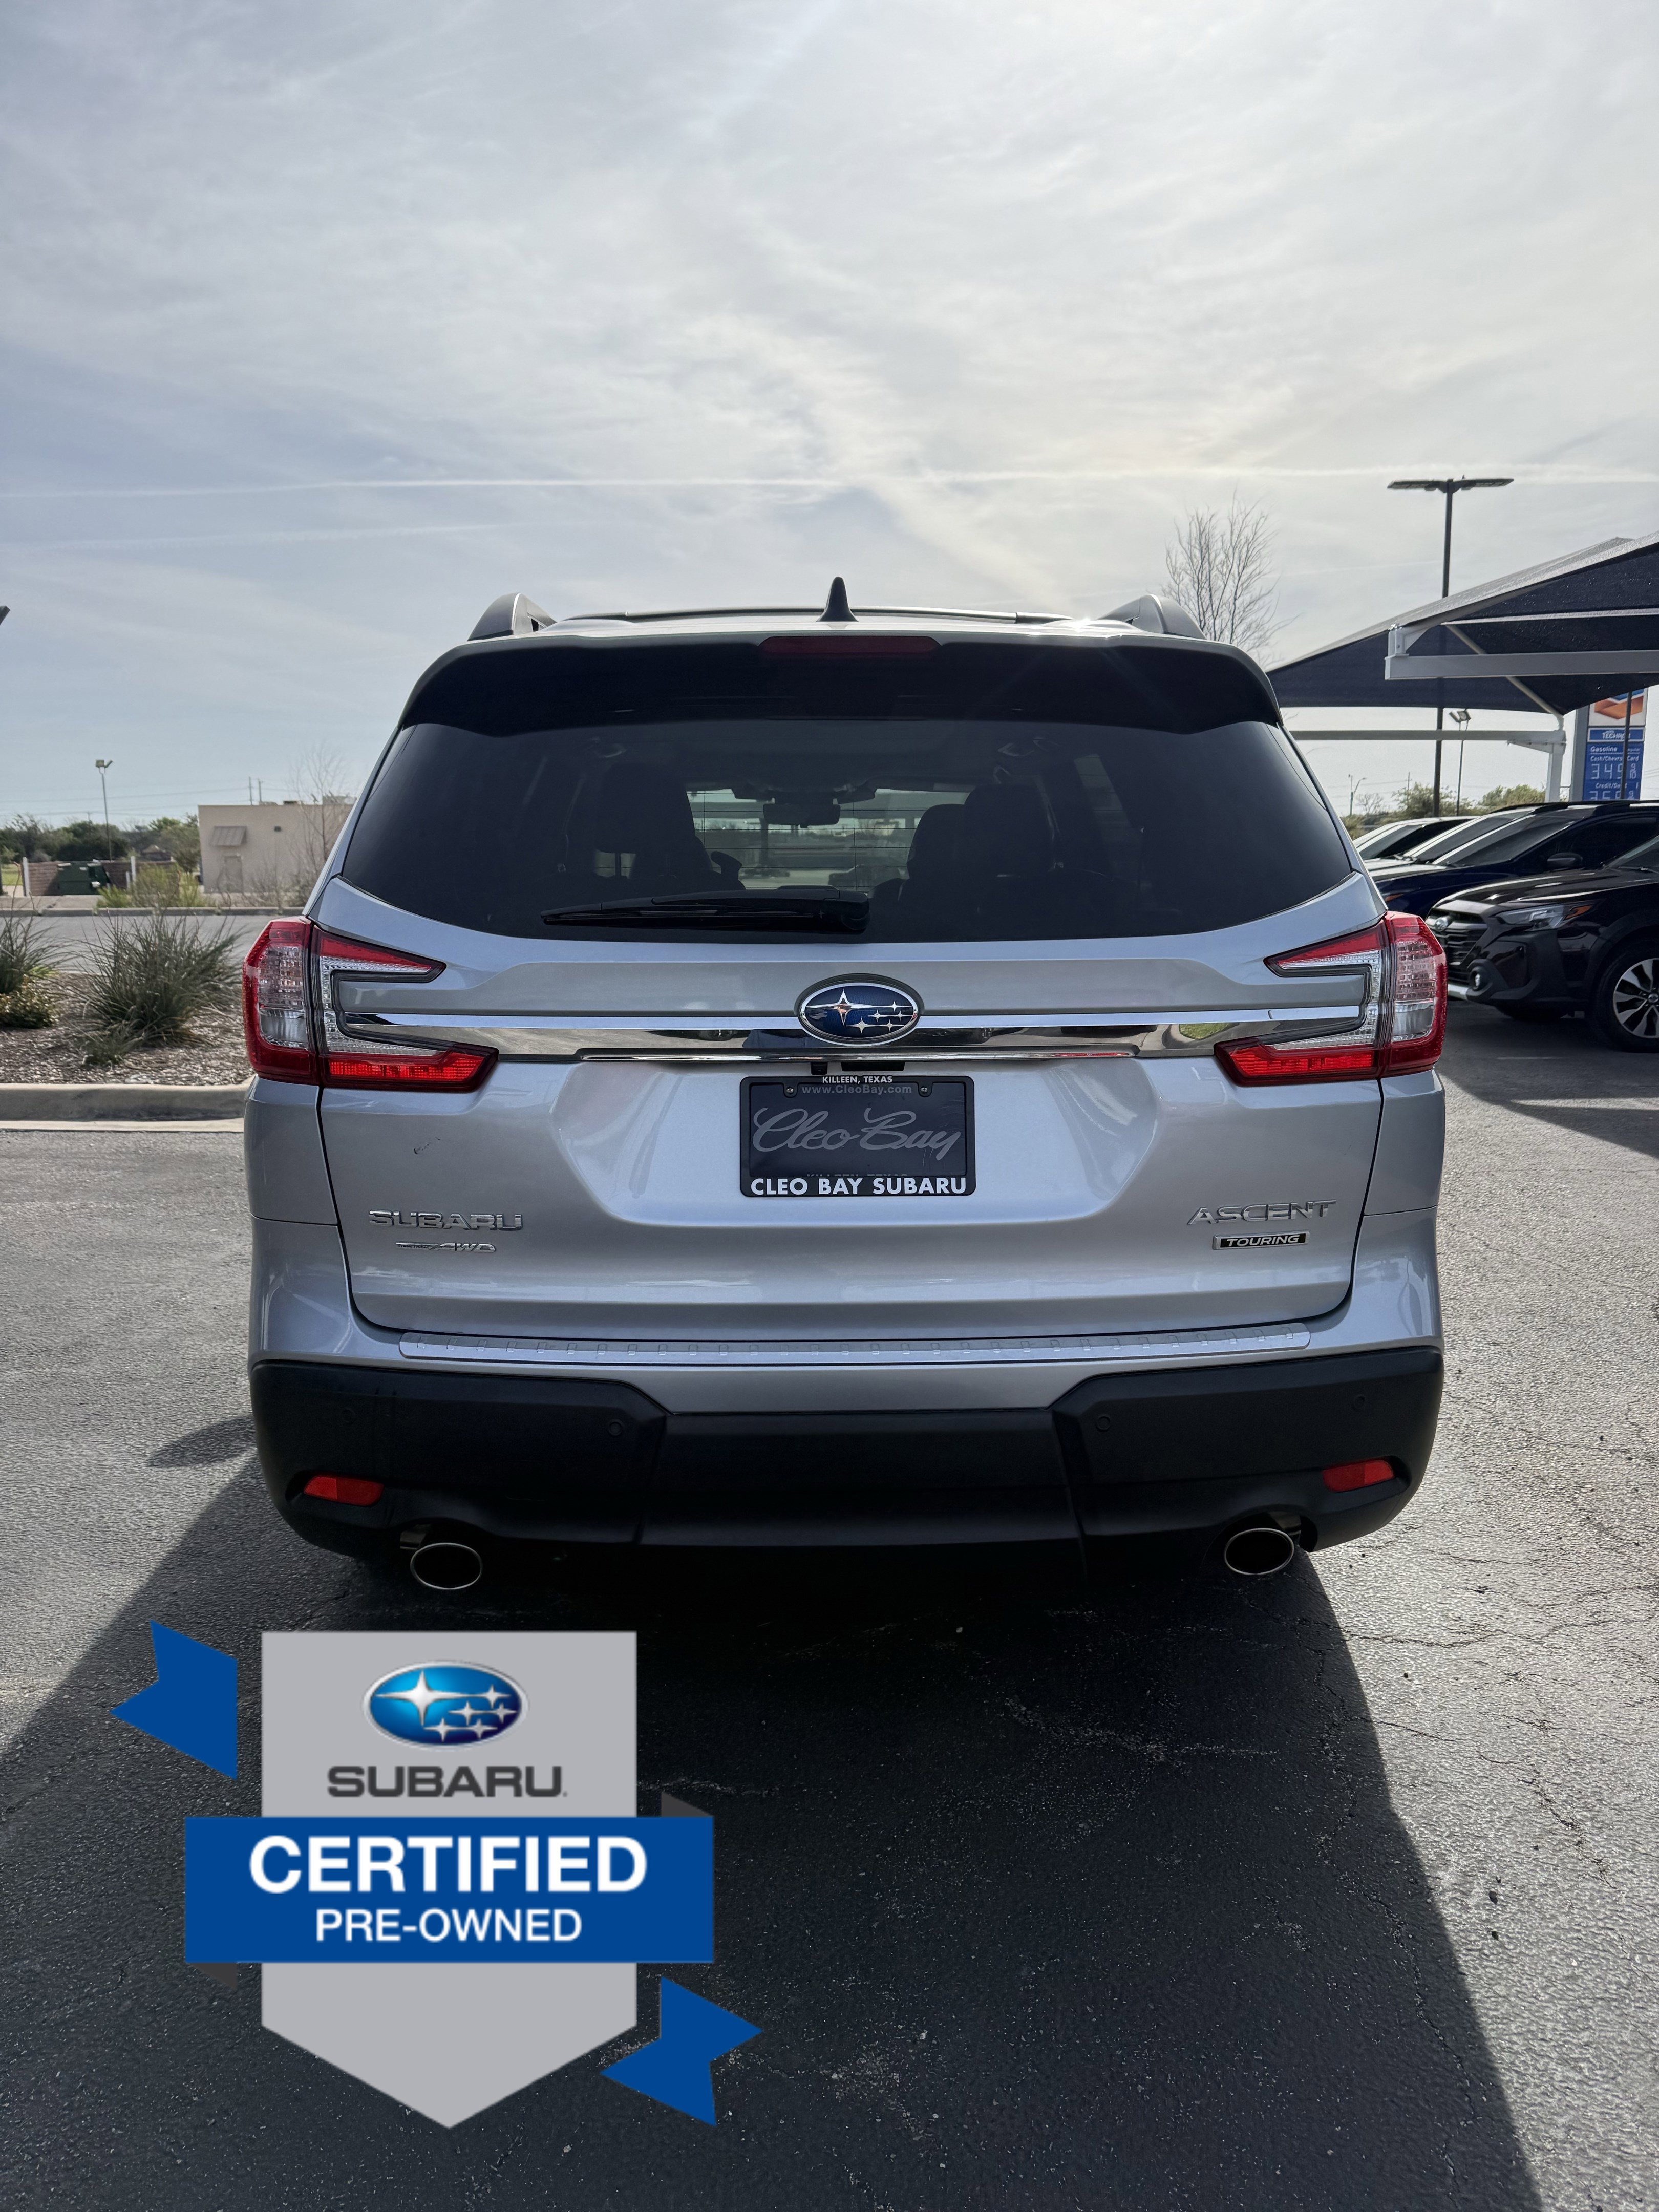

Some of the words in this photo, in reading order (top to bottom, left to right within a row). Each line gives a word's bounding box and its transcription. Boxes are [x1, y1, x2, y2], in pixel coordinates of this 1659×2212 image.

[822, 1076, 860, 1084] KILLEEN,
[801, 1084, 912, 1095] www.CleoBay.com
[752, 1108, 860, 1152] Cleo
[859, 1108, 961, 1161] Bay
[751, 1178, 808, 1195] CLEO
[819, 1178, 863, 1195] BAY
[873, 1177, 967, 1195] SUBARU
[369, 1209, 523, 1230] SUBARU
[1187, 1200, 1336, 1225] ASCENT
[431, 1243, 496, 1253] AWD
[1227, 1235, 1300, 1247] TOURING
